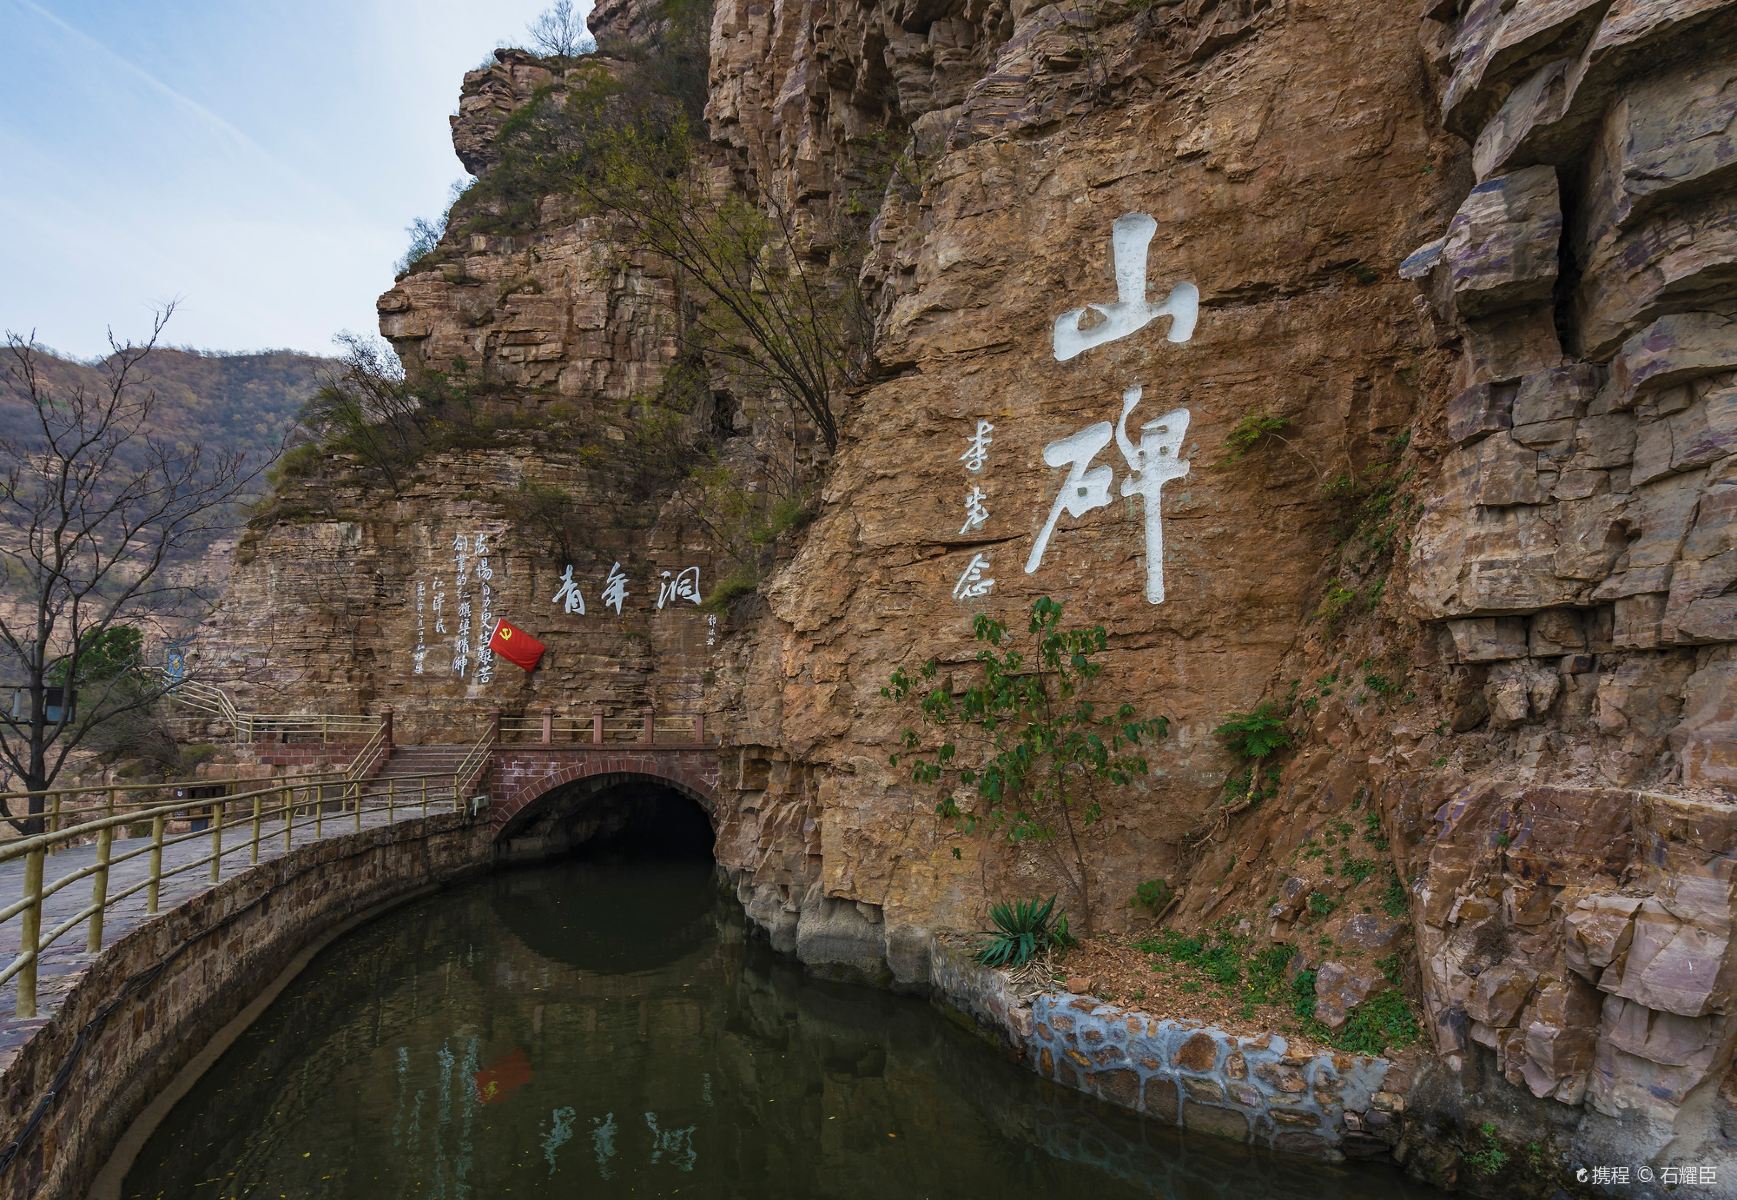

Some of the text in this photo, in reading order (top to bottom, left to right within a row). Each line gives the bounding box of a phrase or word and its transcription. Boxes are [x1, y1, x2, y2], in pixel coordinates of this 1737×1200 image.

[1023, 212, 1199, 604] 山碑
[551, 561, 703, 616] 青年洞
[952, 419, 995, 600] 李先念
